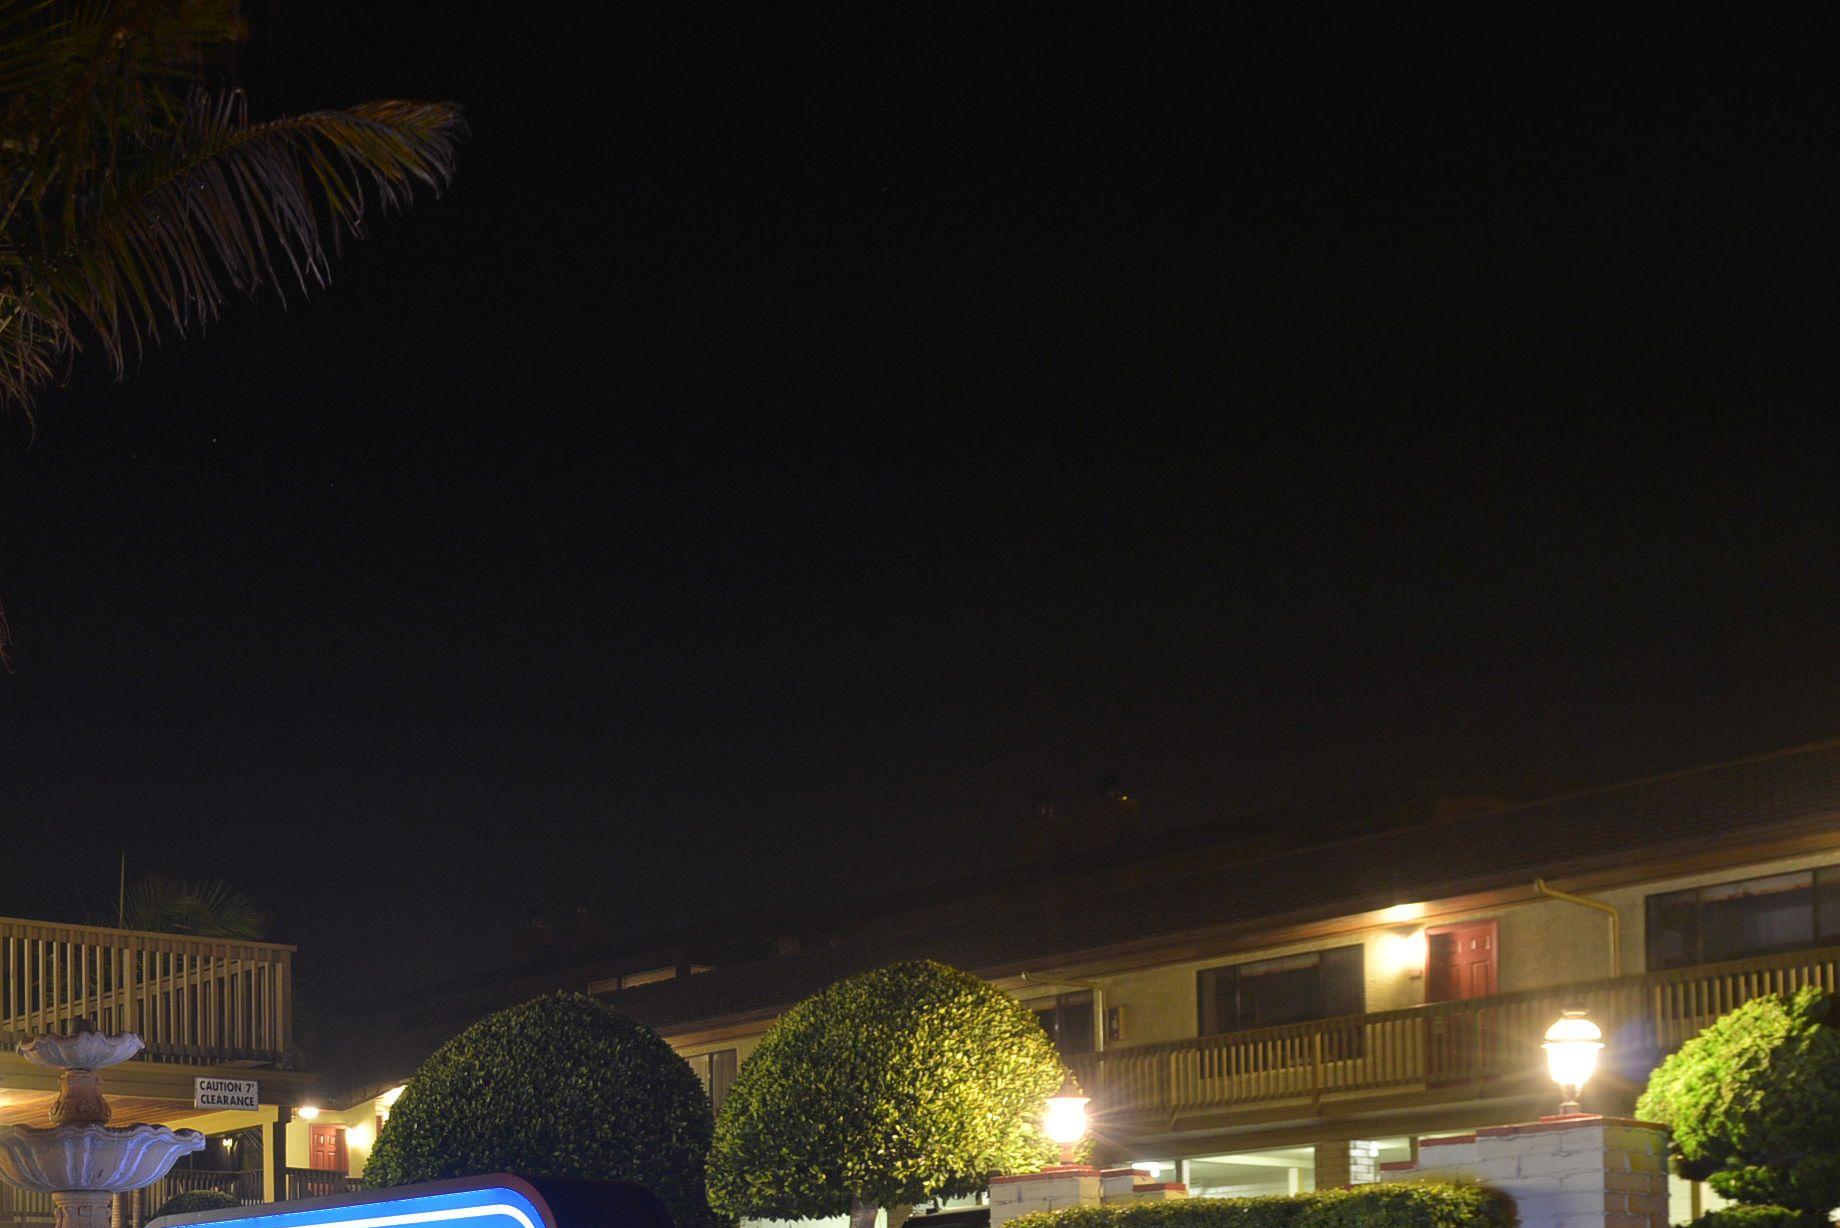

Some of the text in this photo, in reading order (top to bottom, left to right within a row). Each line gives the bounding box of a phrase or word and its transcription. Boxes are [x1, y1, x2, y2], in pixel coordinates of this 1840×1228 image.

[200, 1080, 255, 1093] CAUTION 7'
[200, 1094, 255, 1107] CLEARANCE
